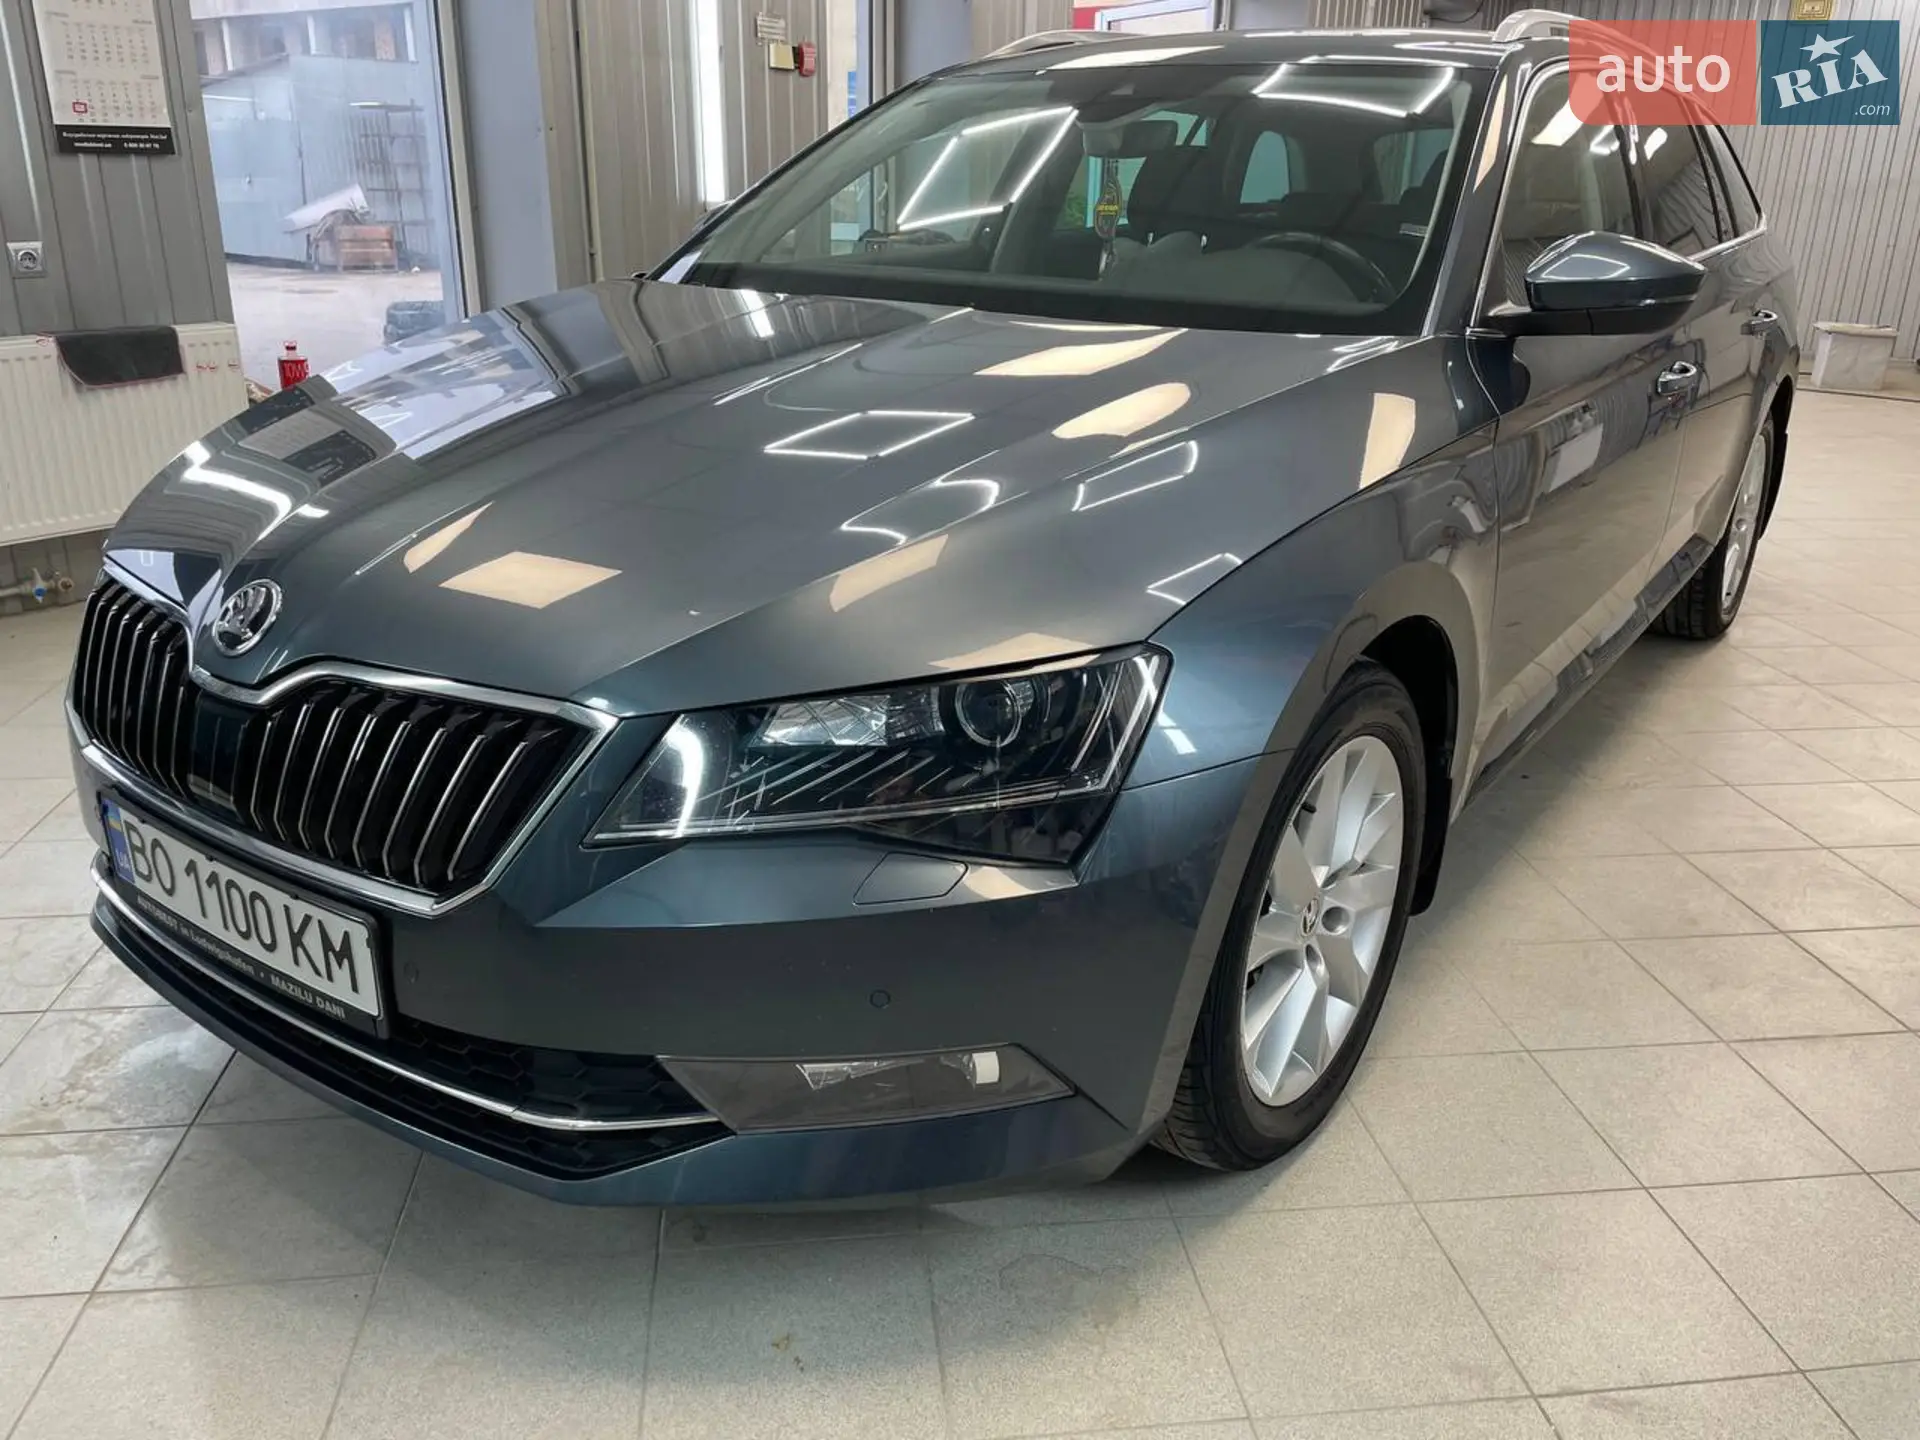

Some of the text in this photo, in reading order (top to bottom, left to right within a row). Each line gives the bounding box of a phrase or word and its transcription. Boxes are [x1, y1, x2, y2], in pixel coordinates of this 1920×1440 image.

[123, 819, 176, 898] BO
[184, 859, 278, 953] 1100
[283, 903, 360, 995] KM
